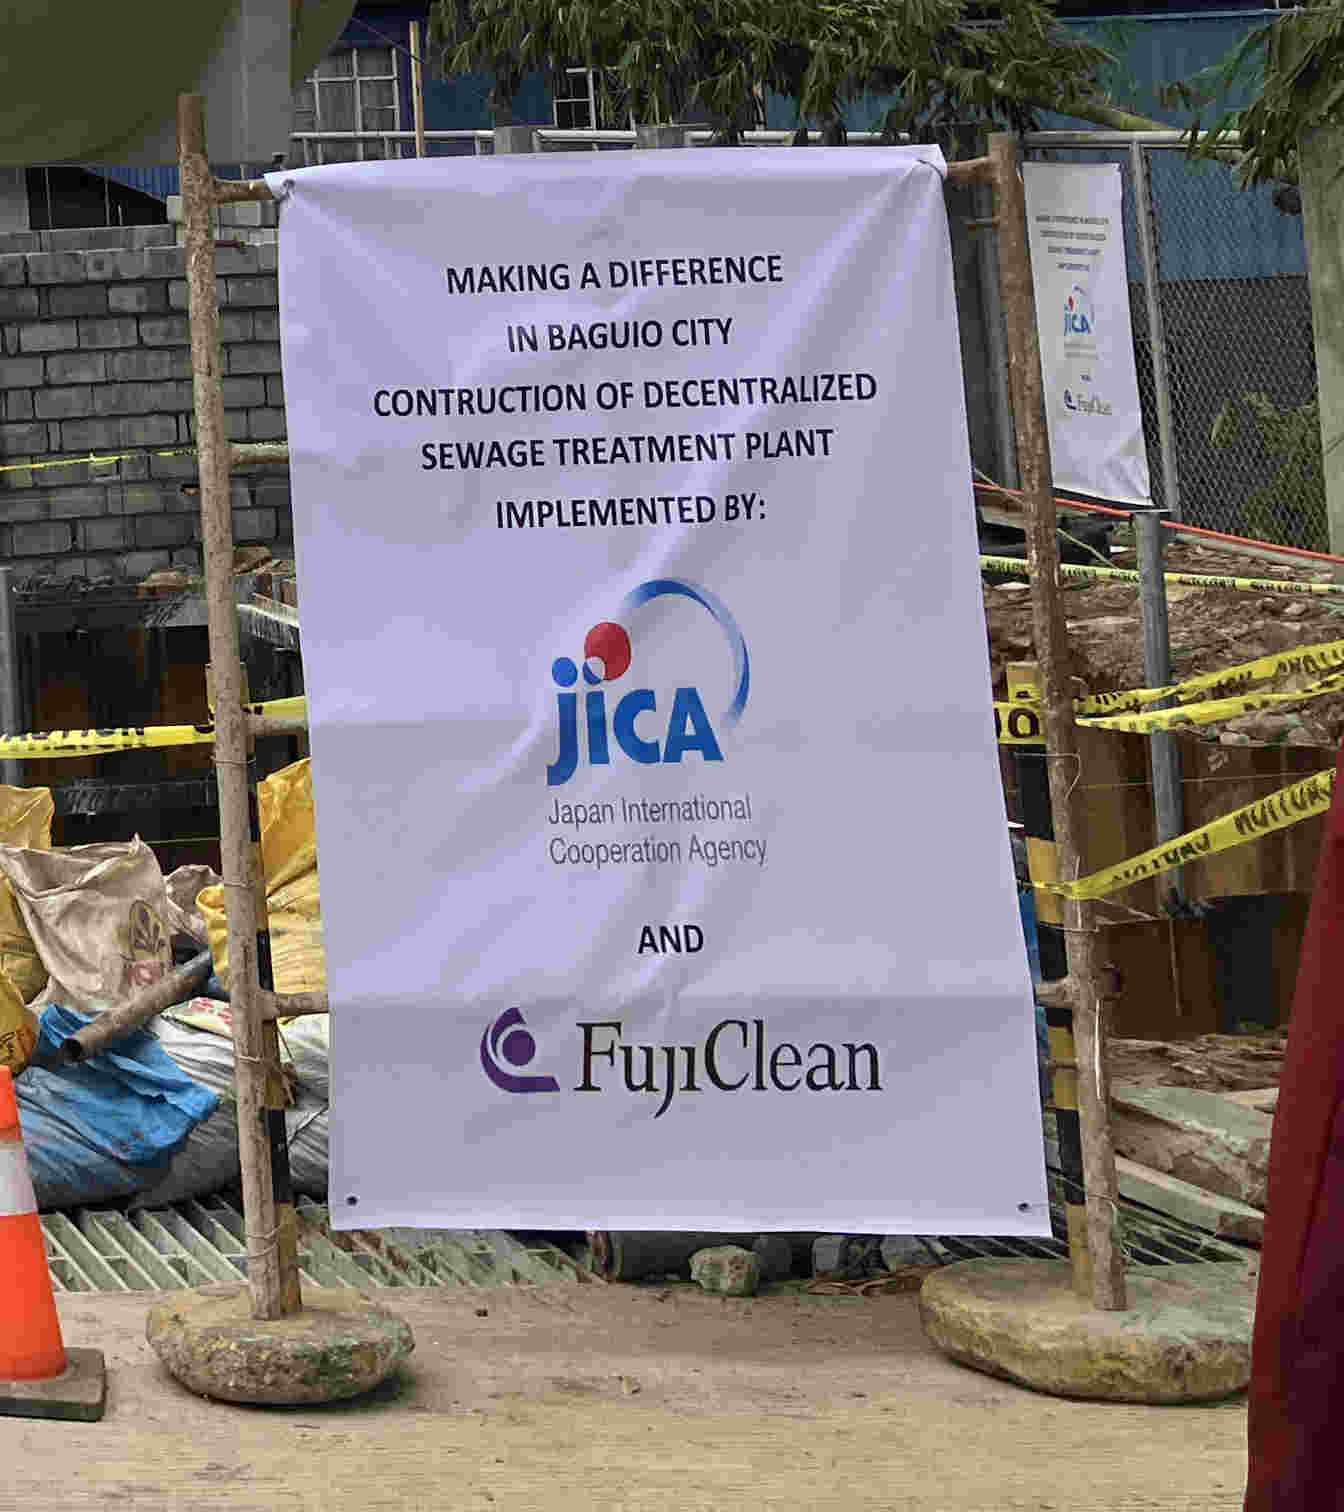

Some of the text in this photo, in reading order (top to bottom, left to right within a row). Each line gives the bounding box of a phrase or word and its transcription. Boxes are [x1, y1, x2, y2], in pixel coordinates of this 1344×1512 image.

[447, 256, 783, 294] MAKING A DIFFERENCE
[508, 318, 732, 352] IN BAGUIO CITY
[374, 374, 876, 416] CONTRUCTION OF DECENTRALIZED
[422, 429, 833, 470] SEWAGE TREATMENT PLANT
[497, 493, 765, 528] IMPLEMENTED BY:
[549, 795, 751, 832] Japan International
[550, 835, 766, 870] Cooperation Agency
[638, 925, 703, 954] AND
[573, 1019, 883, 1118] FujiClean
